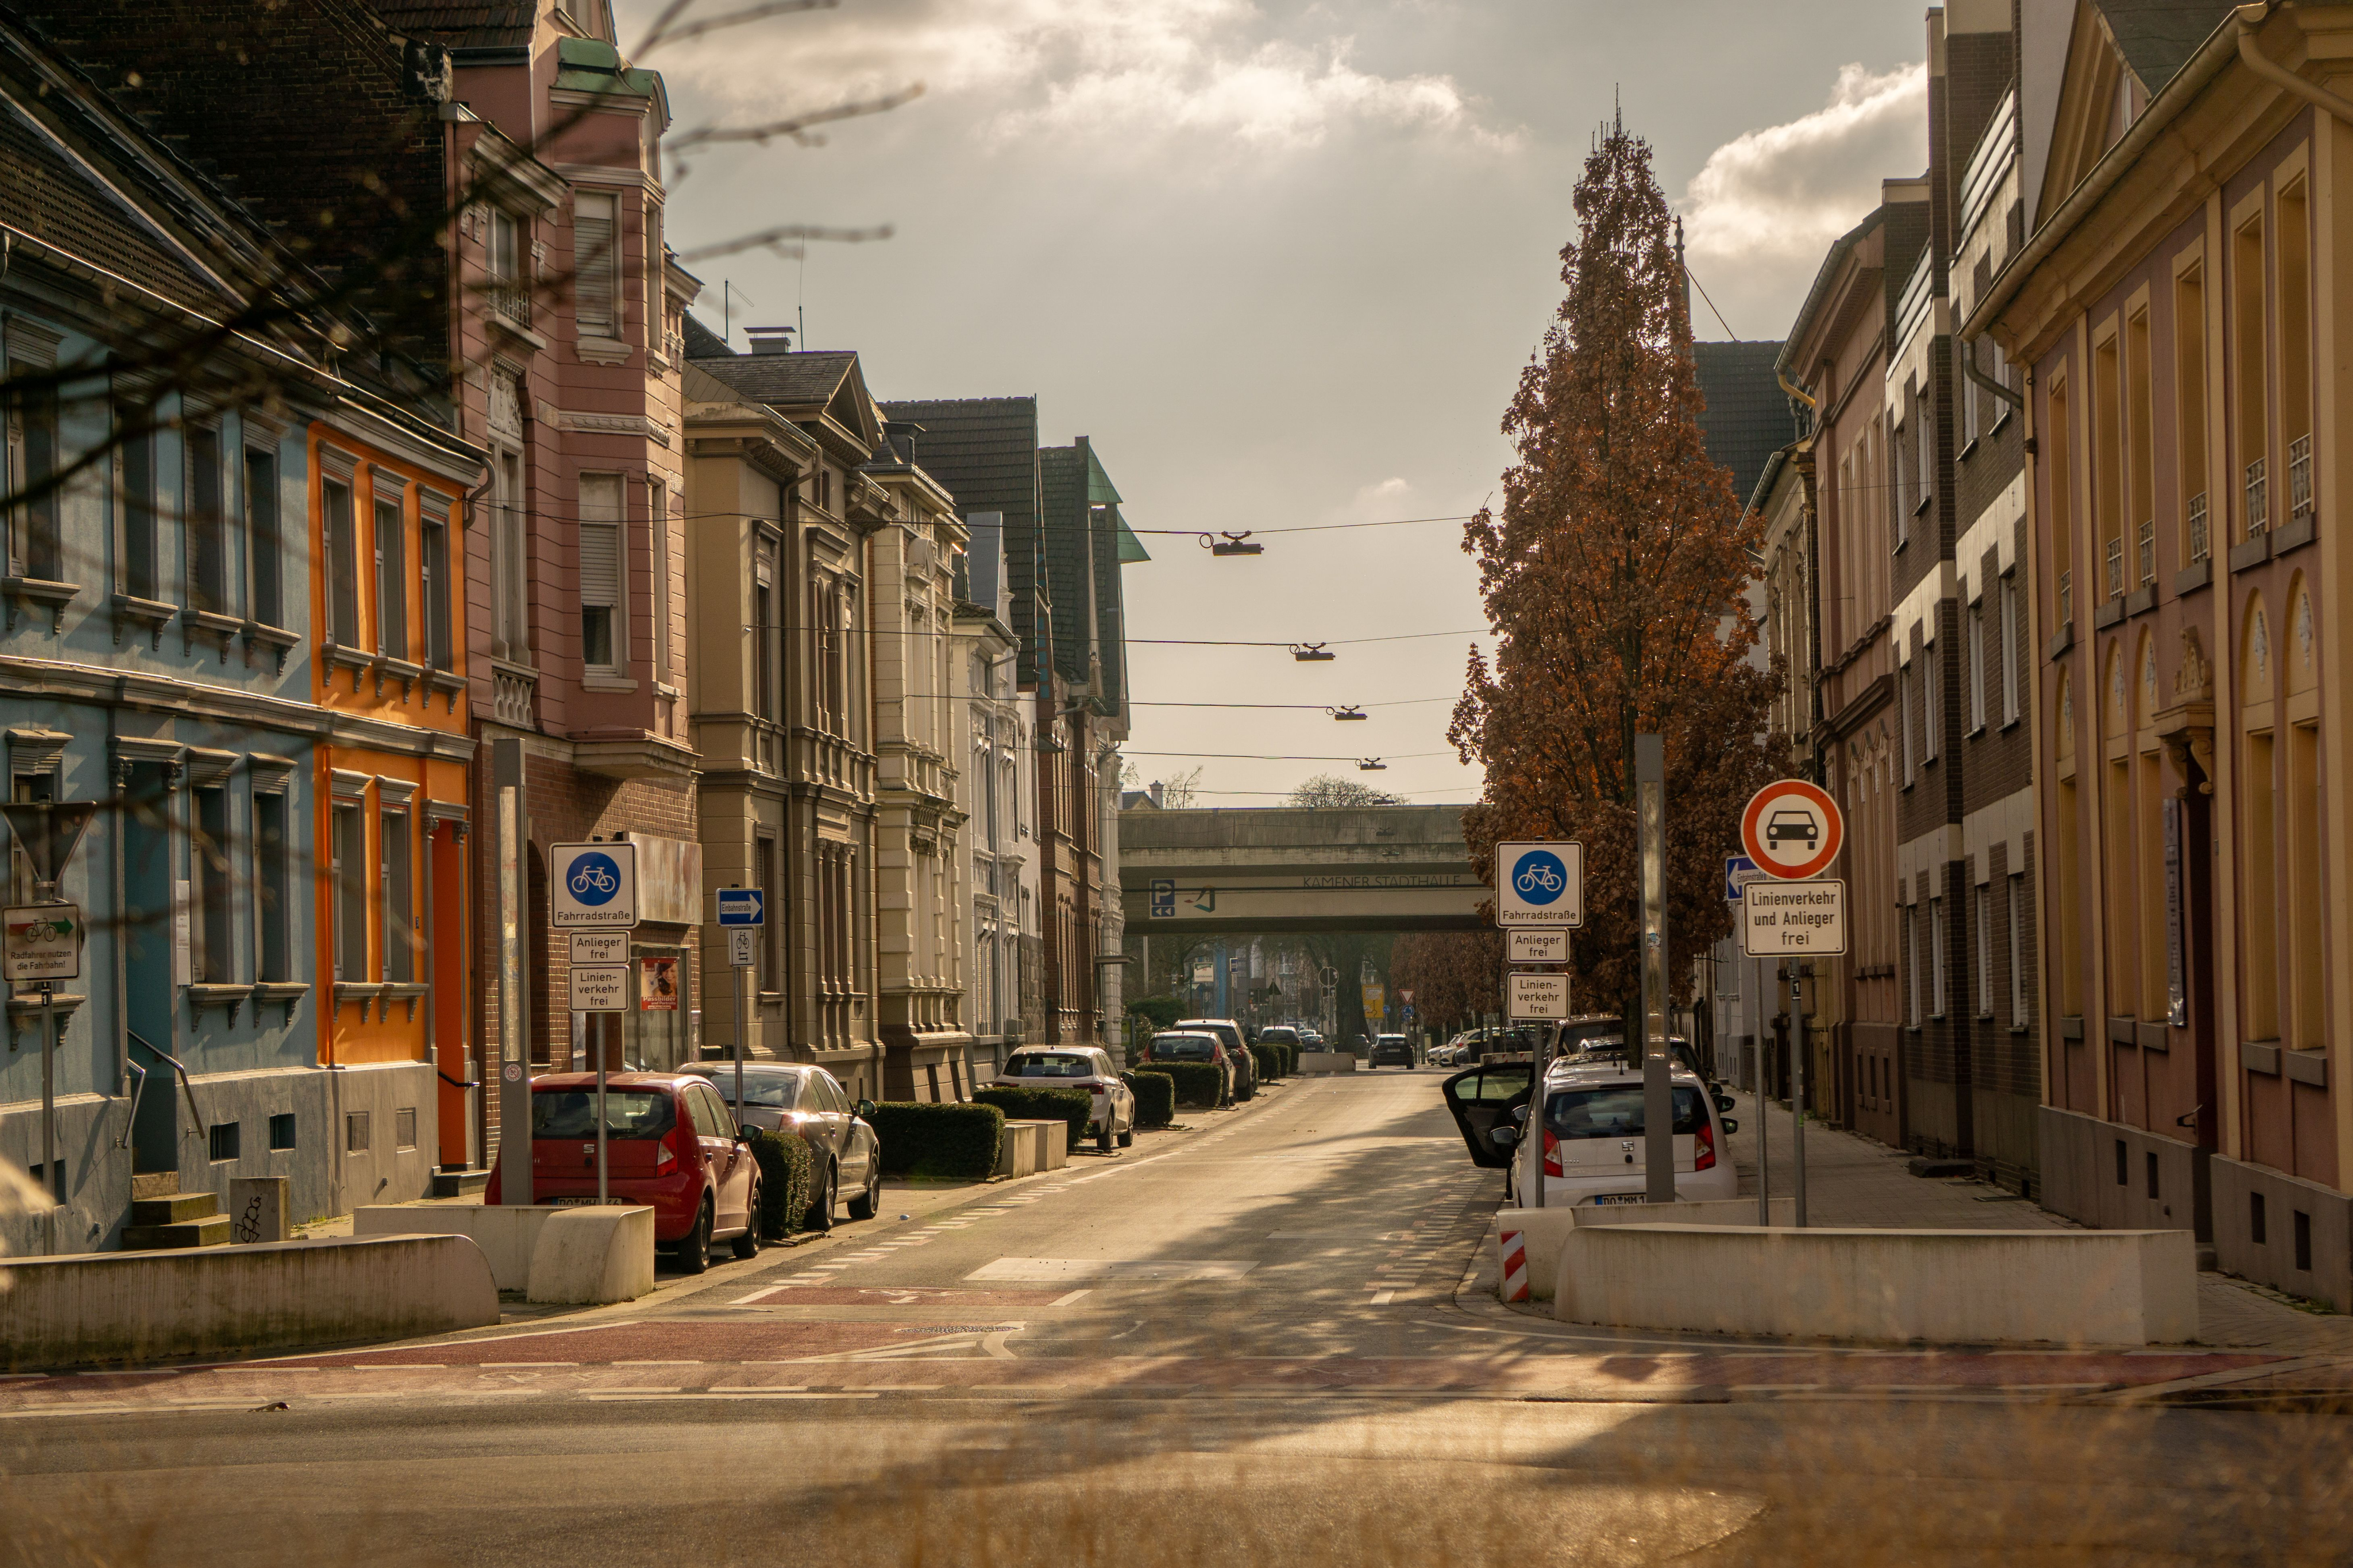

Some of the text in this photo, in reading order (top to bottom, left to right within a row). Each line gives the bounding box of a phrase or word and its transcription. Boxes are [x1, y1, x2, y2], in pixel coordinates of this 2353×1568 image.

[1155, 883, 1172, 903] P
[1752, 891, 1836, 906] Linienverkehr
[722, 903, 751, 912] Einbahnstraße
[558, 911, 630, 920] Fahrradstraße
[1503, 910, 1576, 920] Fahrradstraße
[1754, 911, 1835, 928] und Anlieger
[1515, 935, 1561, 947] Anlieger
[1781, 930, 1810, 945] frei
[576, 937, 622, 949] Anlieger
[11, 951, 71, 959] Radfahrer nutzen
[590, 949, 608, 959] frei
[1529, 947, 1548, 956] frei
[17, 960, 65, 970] die Fahrbahn!
[580, 972, 617, 982] Linien-
[578, 984, 619, 994] verkehr
[1520, 980, 1557, 989] Linien-
[1793, 982, 1799, 992] 1
[590, 997, 608, 1006] frei
[1518, 992, 1560, 1002] verkehr
[1530, 1004, 1548, 1013] frei
